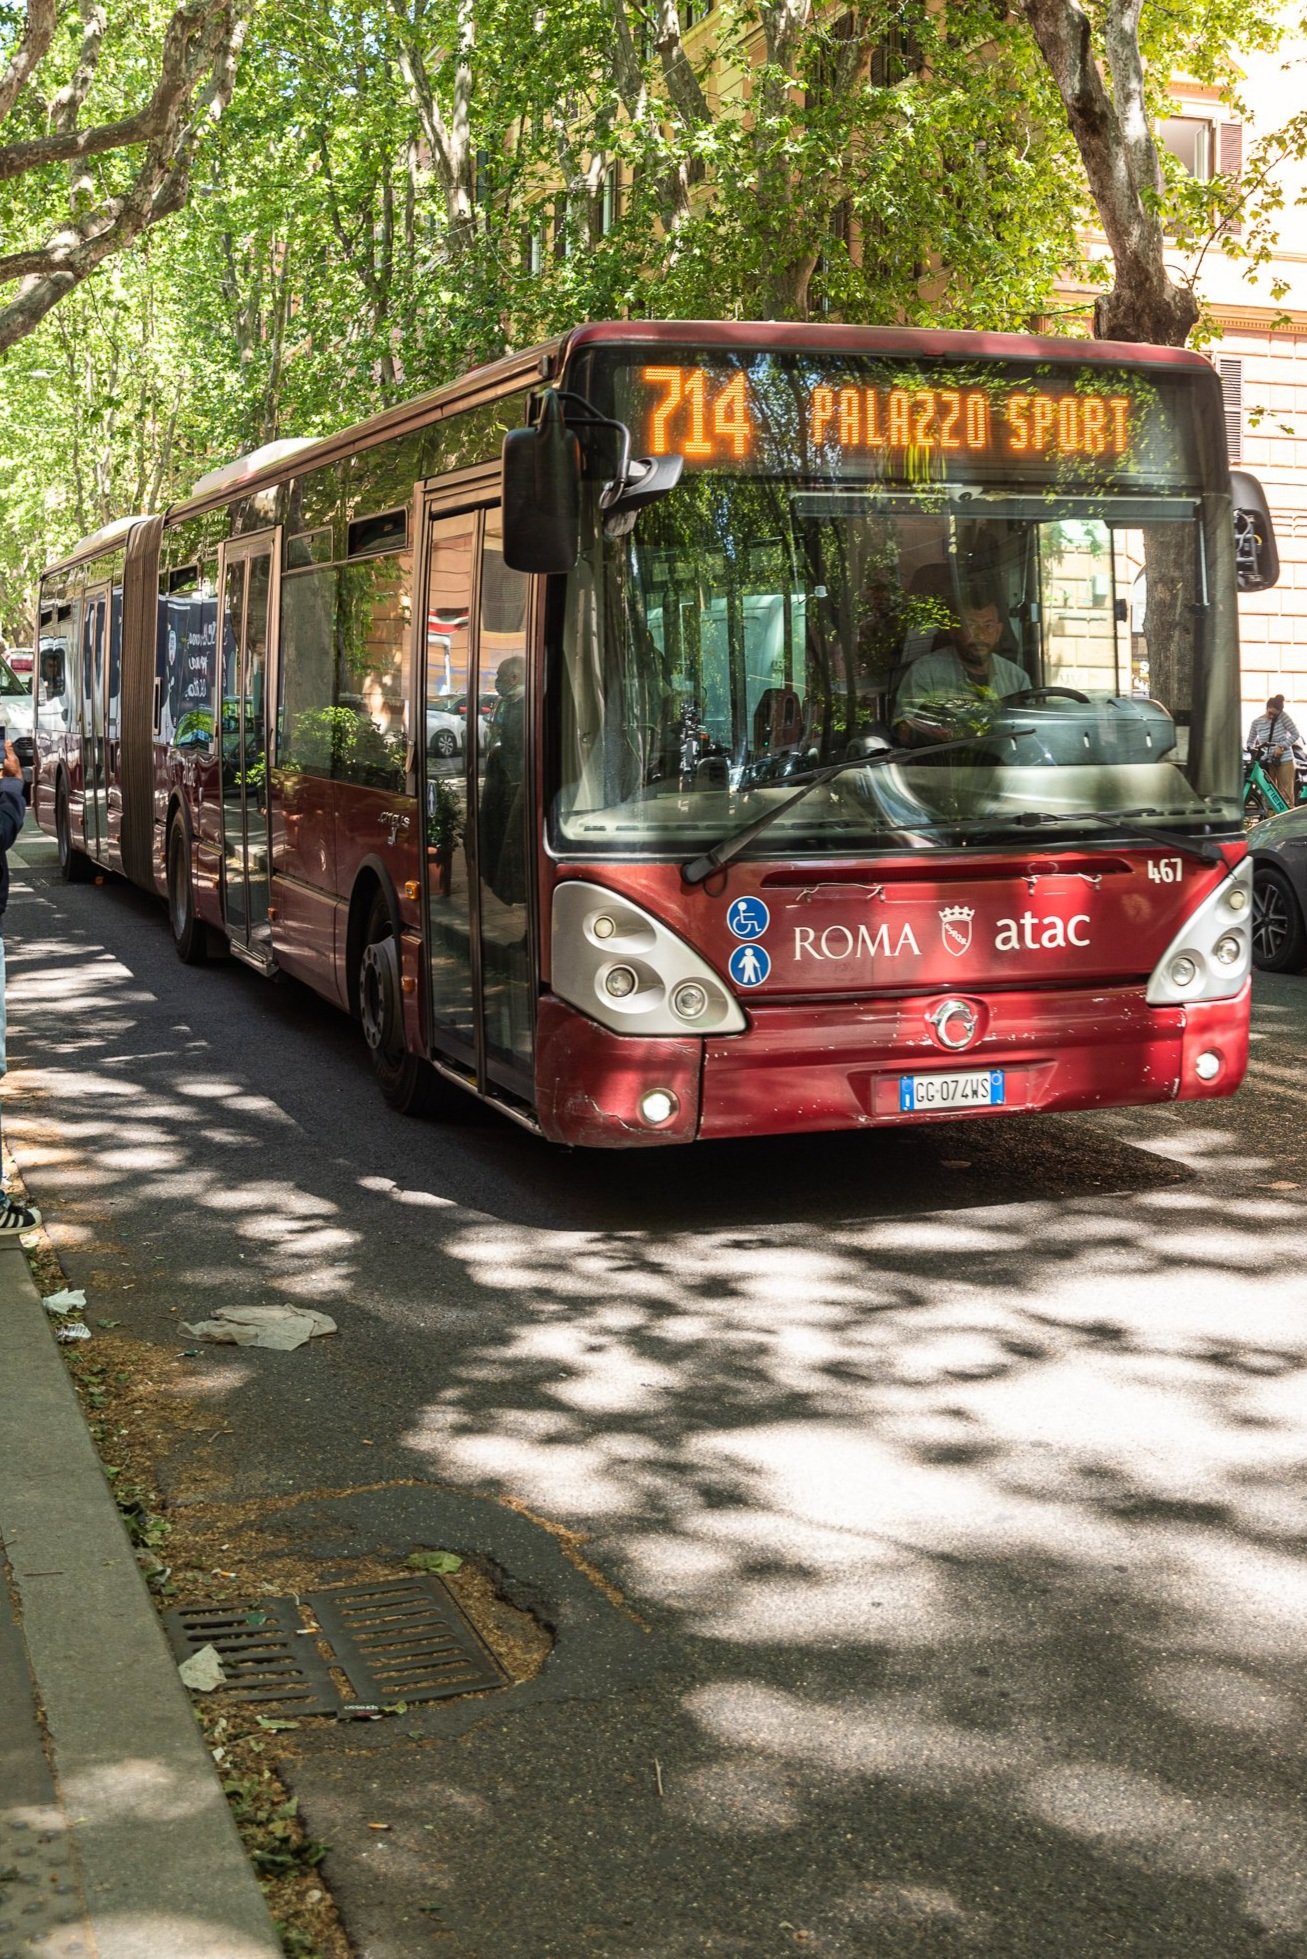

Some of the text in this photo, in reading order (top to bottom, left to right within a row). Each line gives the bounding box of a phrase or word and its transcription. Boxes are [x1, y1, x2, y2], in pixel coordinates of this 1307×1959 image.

[644, 367, 1129, 455] 714 PALAZZO SPORT
[1267, 785, 1285, 810] TIER
[1147, 857, 1183, 884] 467
[793, 923, 922, 961] ROMA
[994, 911, 1091, 951] atac
